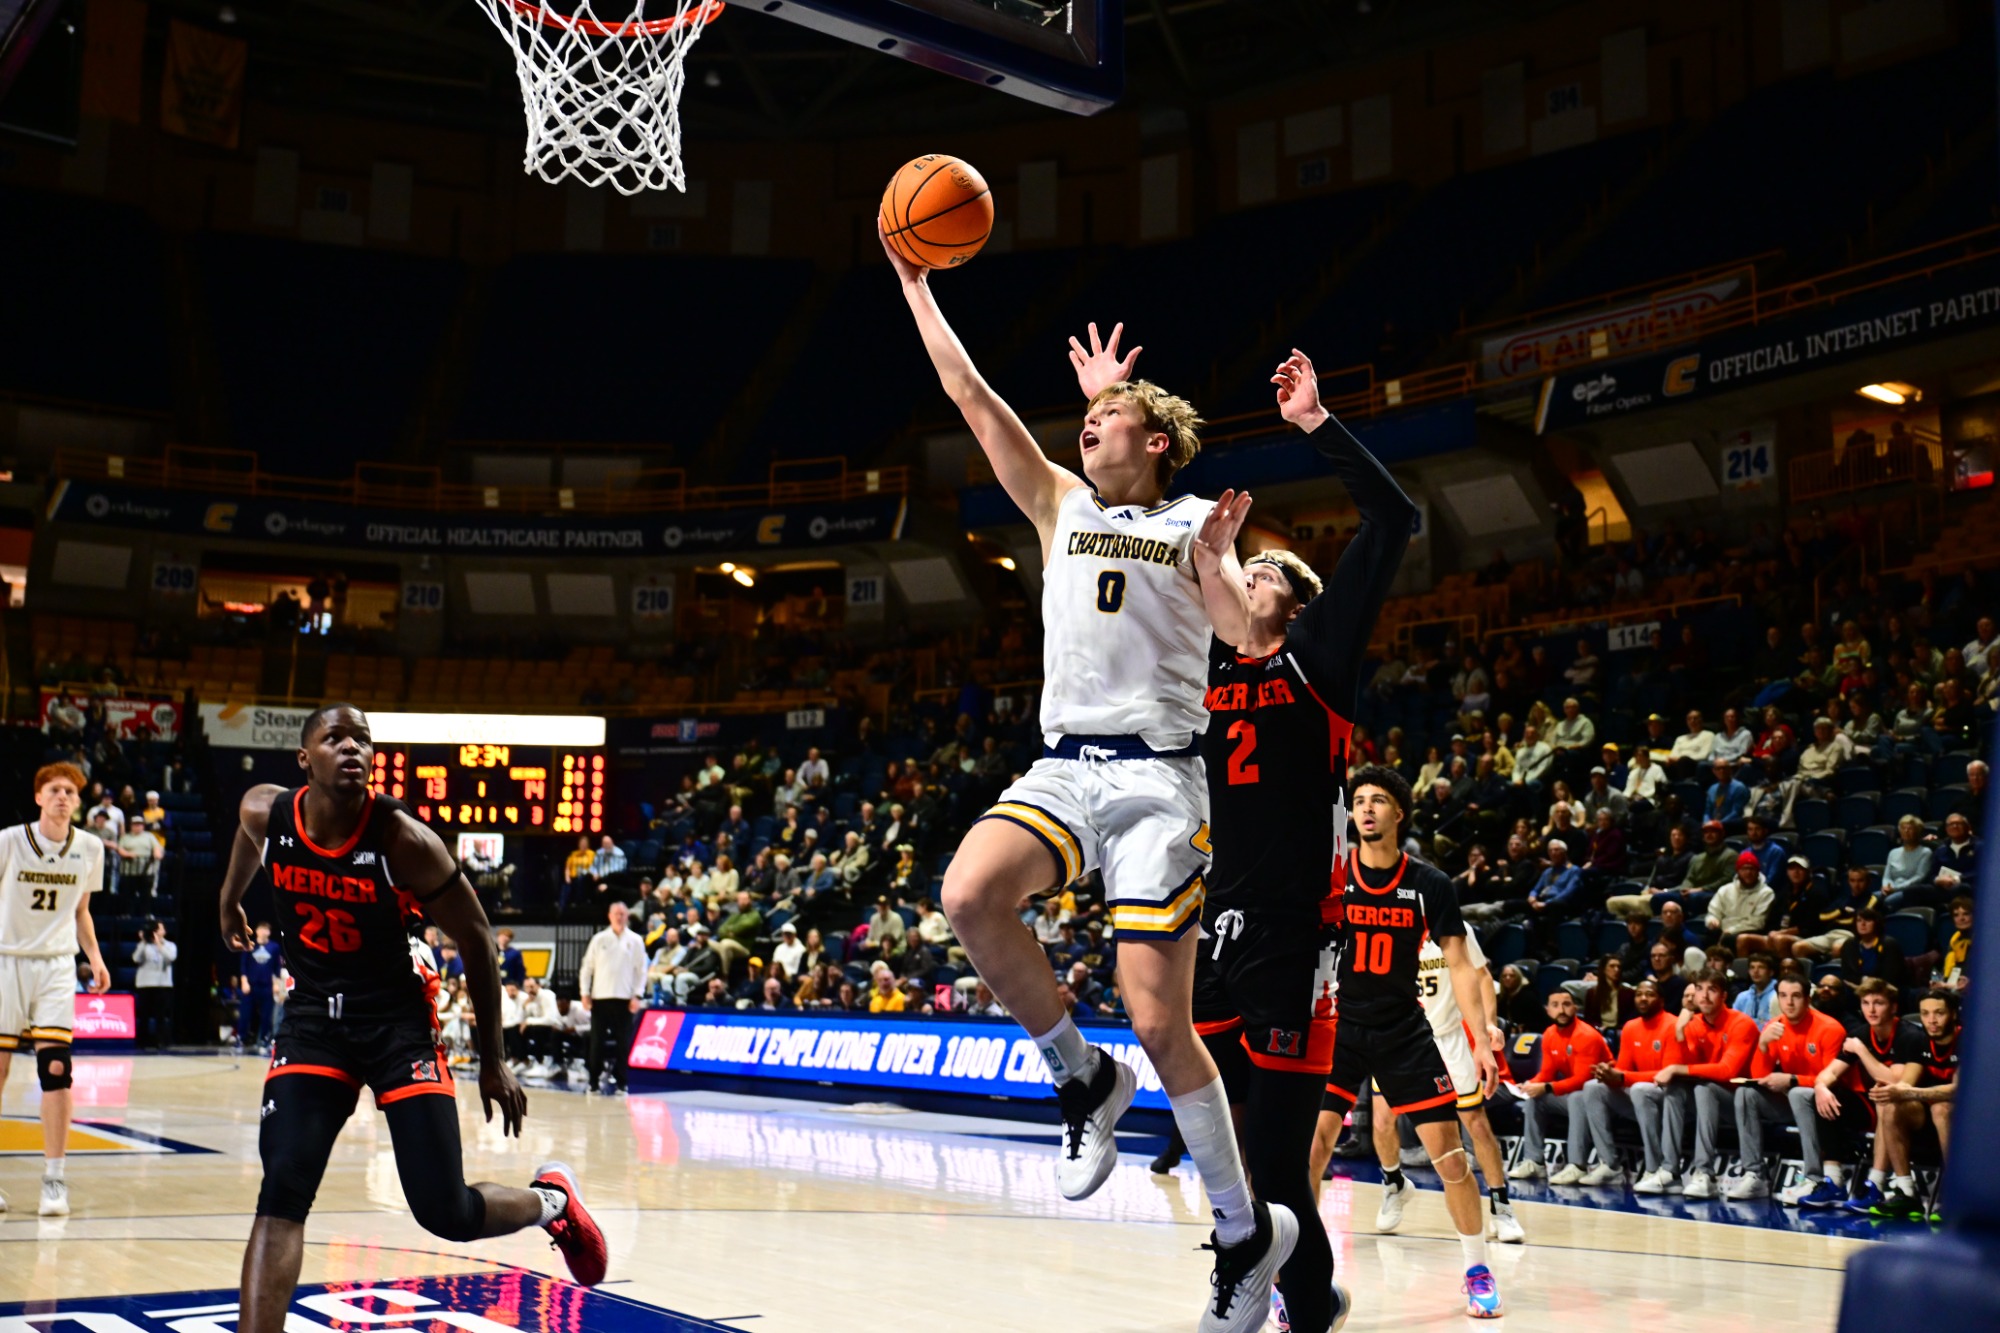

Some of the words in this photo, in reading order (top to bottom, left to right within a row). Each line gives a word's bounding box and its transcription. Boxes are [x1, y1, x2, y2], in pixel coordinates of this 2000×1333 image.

[1709, 340, 1800, 384] OFFICIAL
[1805, 307, 1923, 359] INTERNET
[1728, 446, 1768, 480] 214
[366, 523, 442, 545] OFFICIAL
[447, 527, 560, 548] HEALTHCARE
[563, 529, 644, 548] PARTNER
[1067, 531, 1180, 568] CHATTANOOGA
[154, 566, 195, 589] 209
[1096, 569, 1126, 614] 0
[405, 585, 441, 607] 210
[637, 589, 669, 611] 210
[459, 744, 509, 768] 12:34
[1226, 719, 1260, 787] 2
[426, 777, 447, 801] 13
[524, 779, 545, 801] 14
[17, 870, 77, 886] CHATTANOOGA
[272, 862, 377, 904] MERCER
[31, 888, 58, 911] 21
[294, 902, 363, 954] 26
[1353, 931, 1393, 976] 10
[684, 1024, 771, 1065] PROUDLY
[761, 1028, 882, 1073] EMPLOYING
[875, 1032, 941, 1077] OVER
[940, 1035, 1006, 1081] 1000
